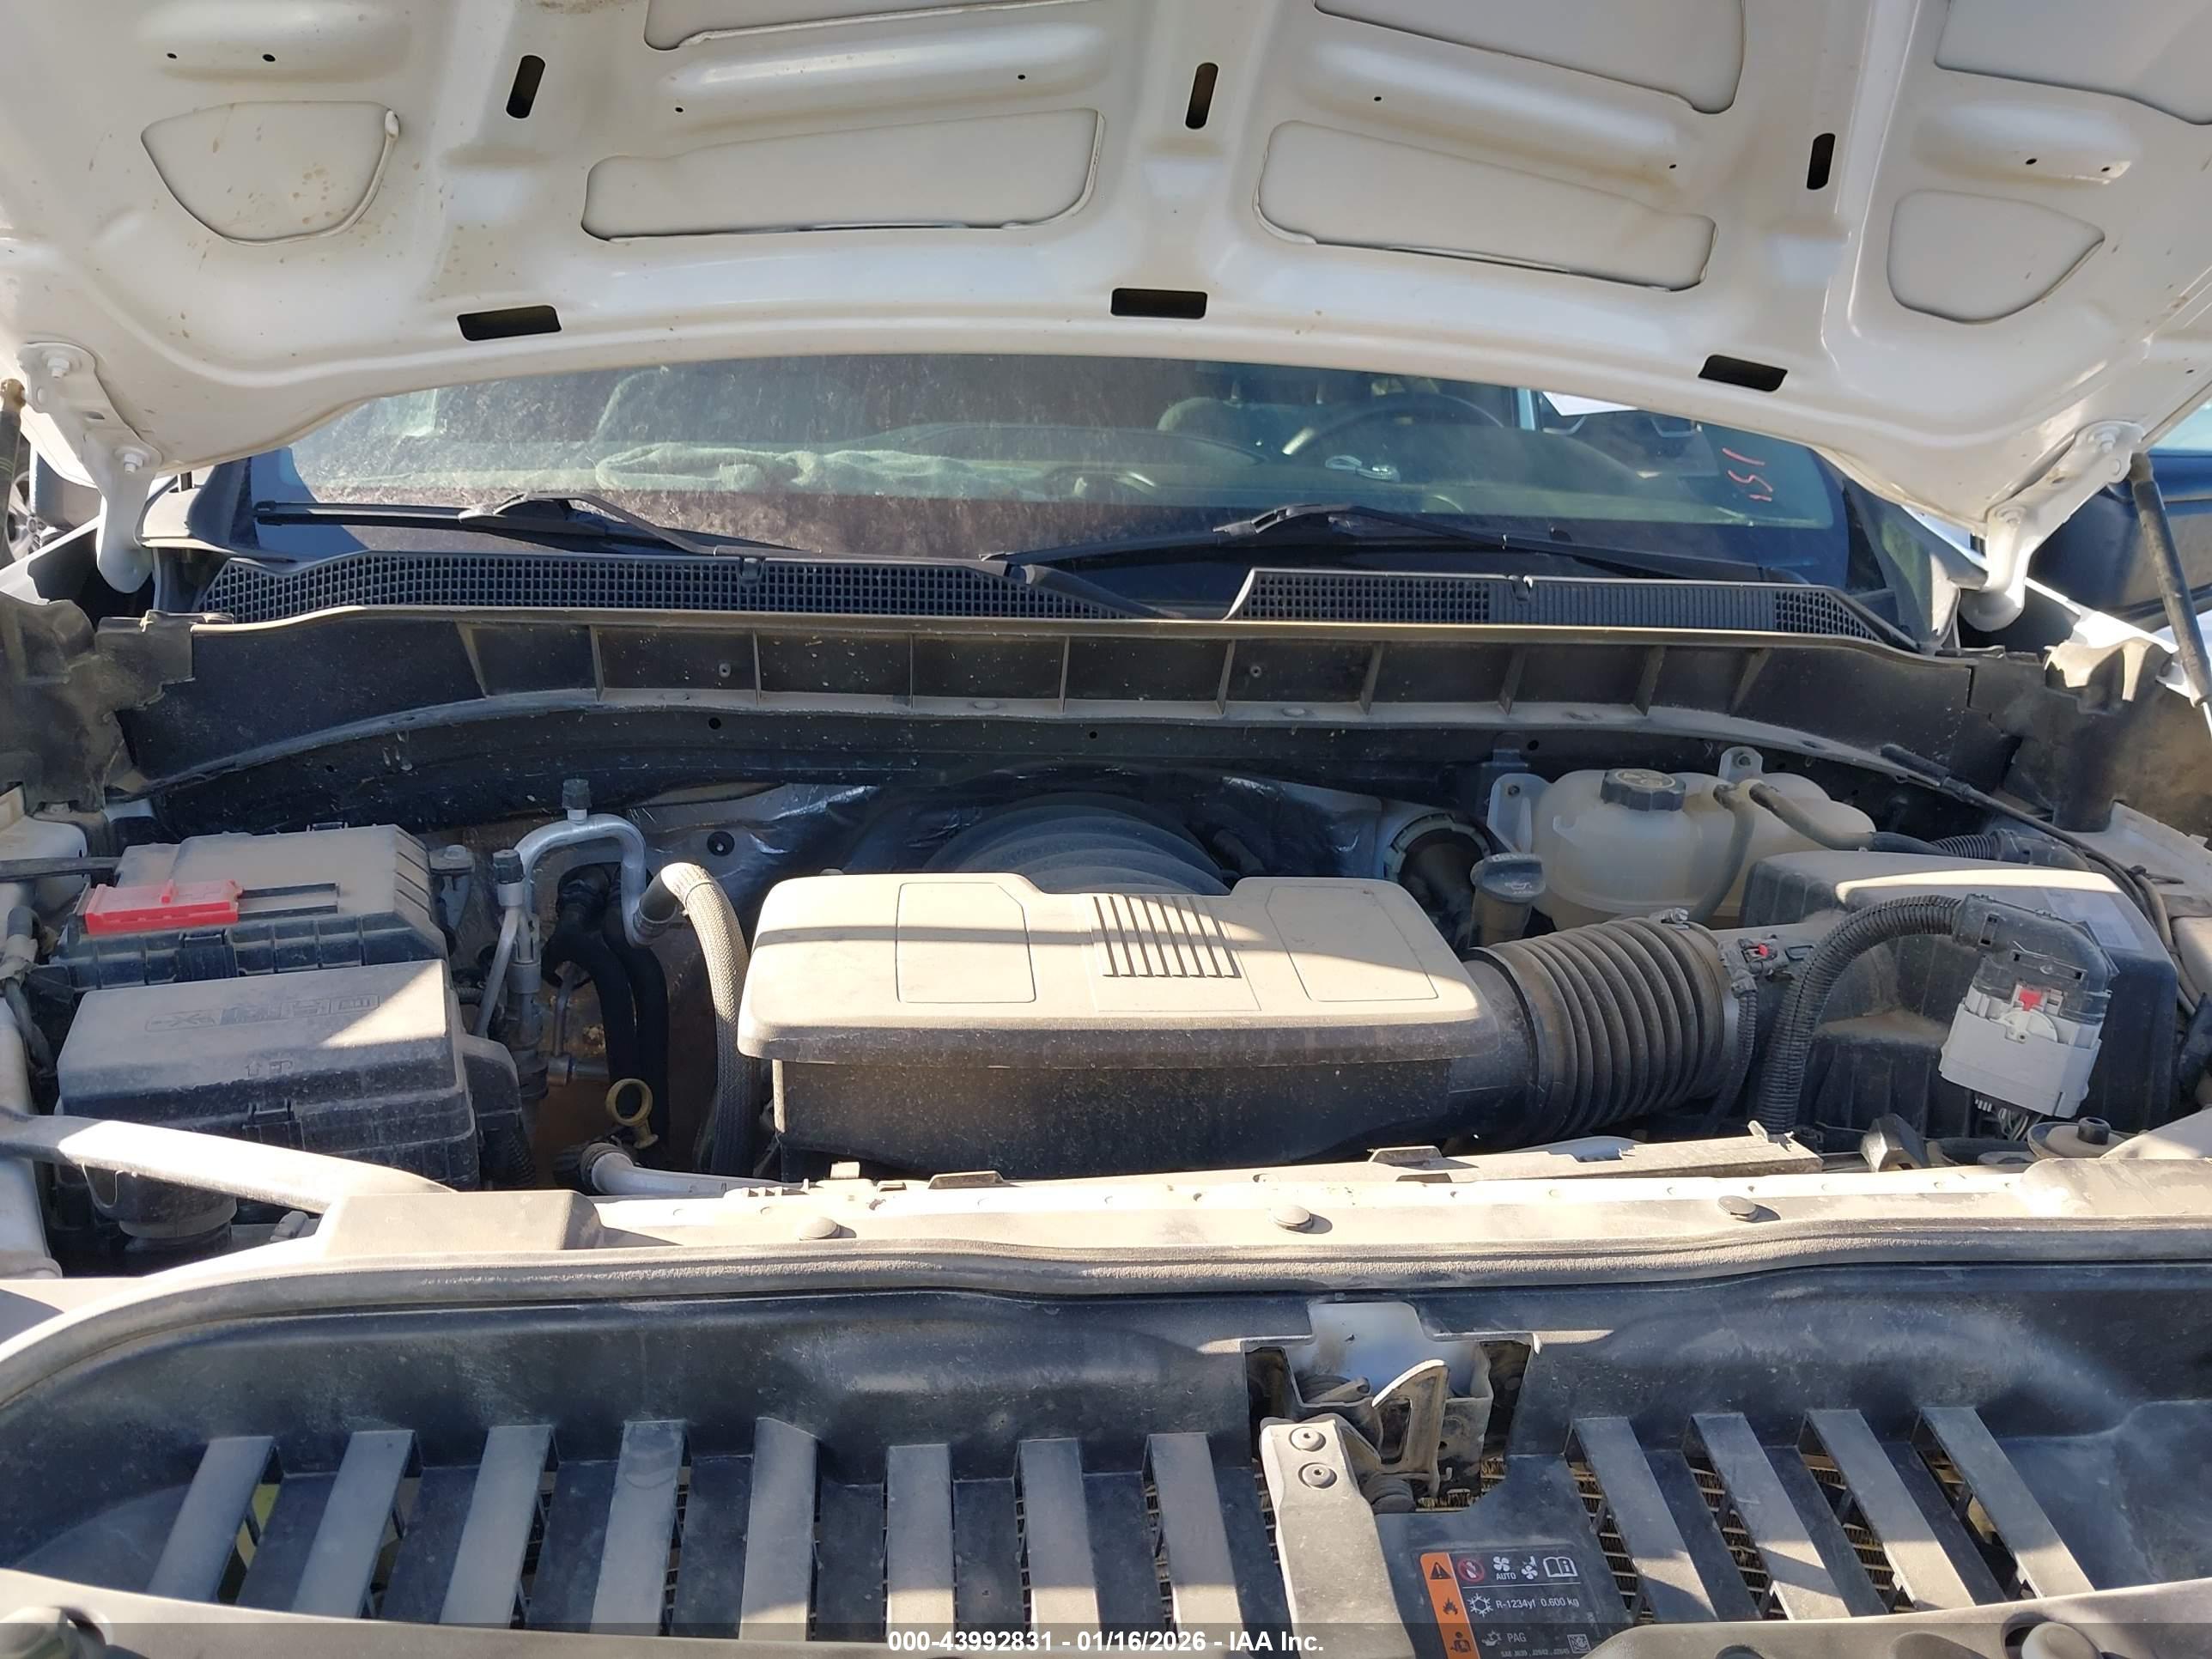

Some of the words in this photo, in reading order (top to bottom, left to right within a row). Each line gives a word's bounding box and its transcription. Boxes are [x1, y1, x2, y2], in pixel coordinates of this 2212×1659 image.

[1495, 1571, 1516, 1581] AUTO
[1495, 1597, 1536, 1609] R-1234yf
[1540, 1597, 1566, 1607] 0.600
[1567, 1596, 1580, 1607] kg
[1506, 1632, 1527, 1643] PAG
